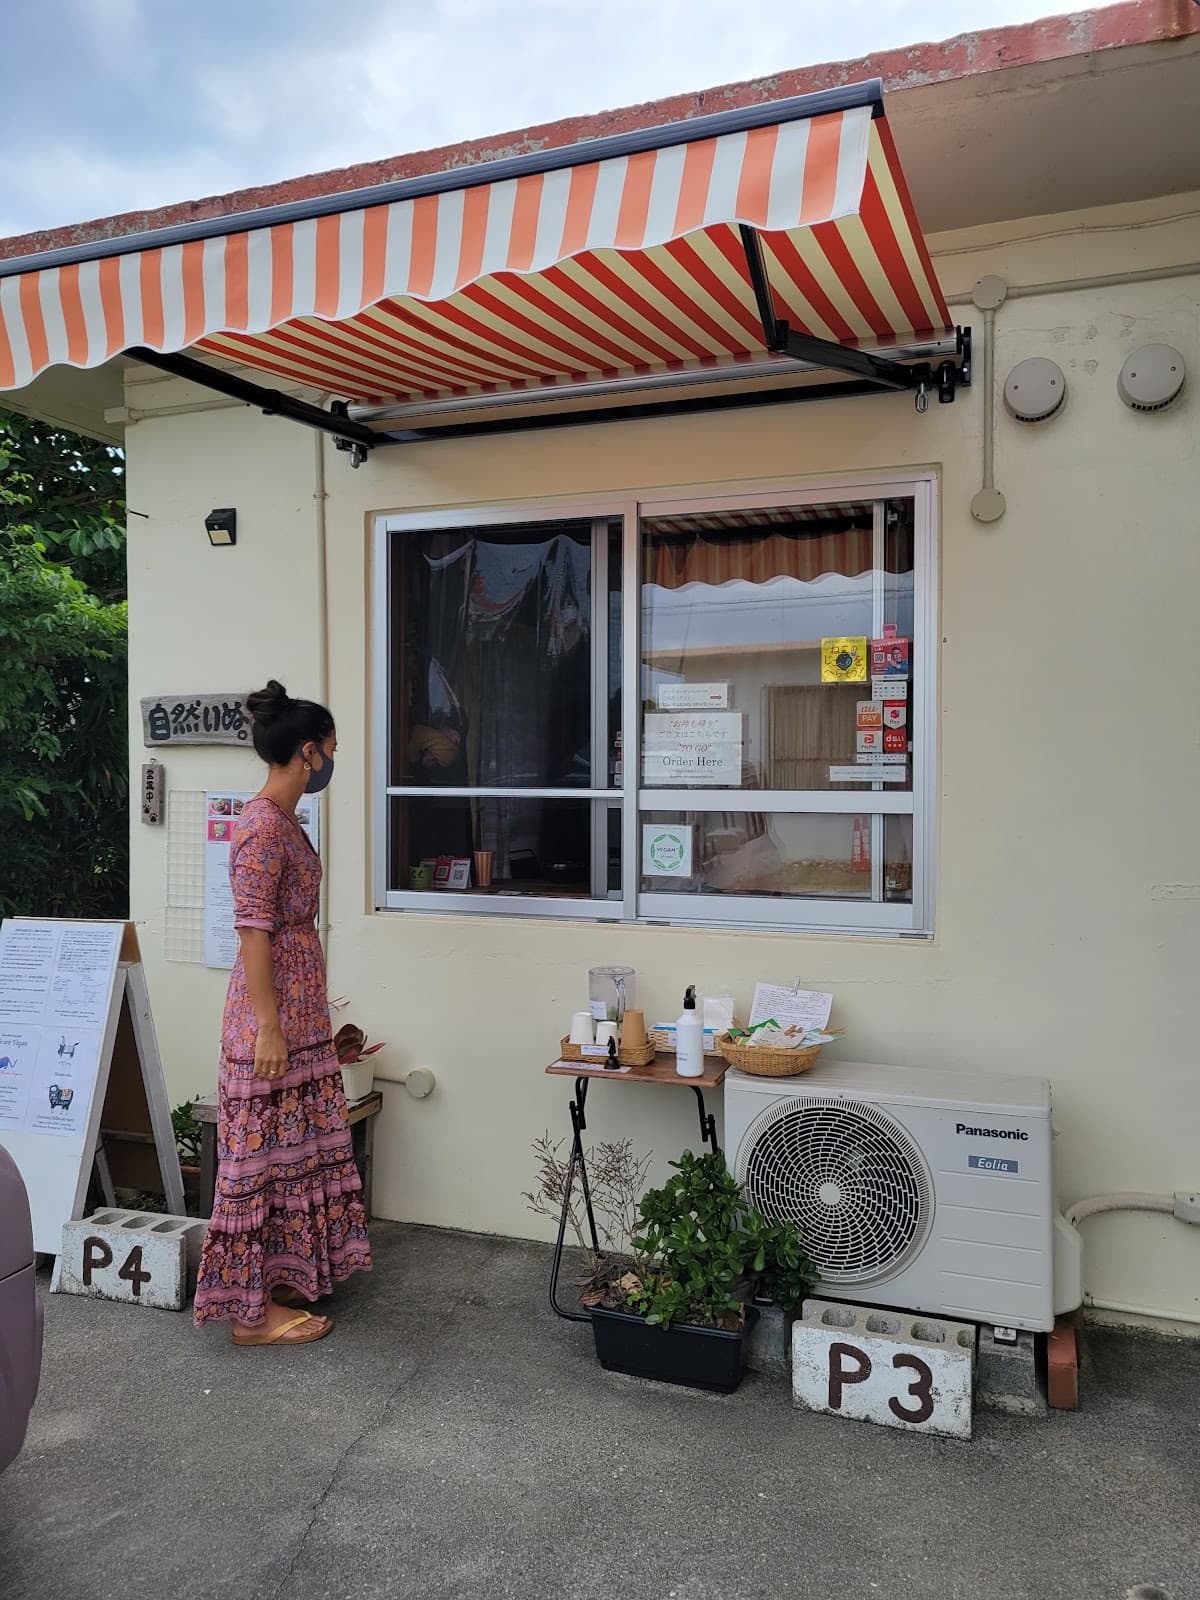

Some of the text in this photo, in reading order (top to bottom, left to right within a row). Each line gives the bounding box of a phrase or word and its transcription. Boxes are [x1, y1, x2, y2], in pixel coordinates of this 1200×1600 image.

[662, 755, 723, 767] Order Here
[956, 1123, 1029, 1141] Panasonic
[977, 1158, 1009, 1171] Eolia
[82, 1236, 152, 1297] P4
